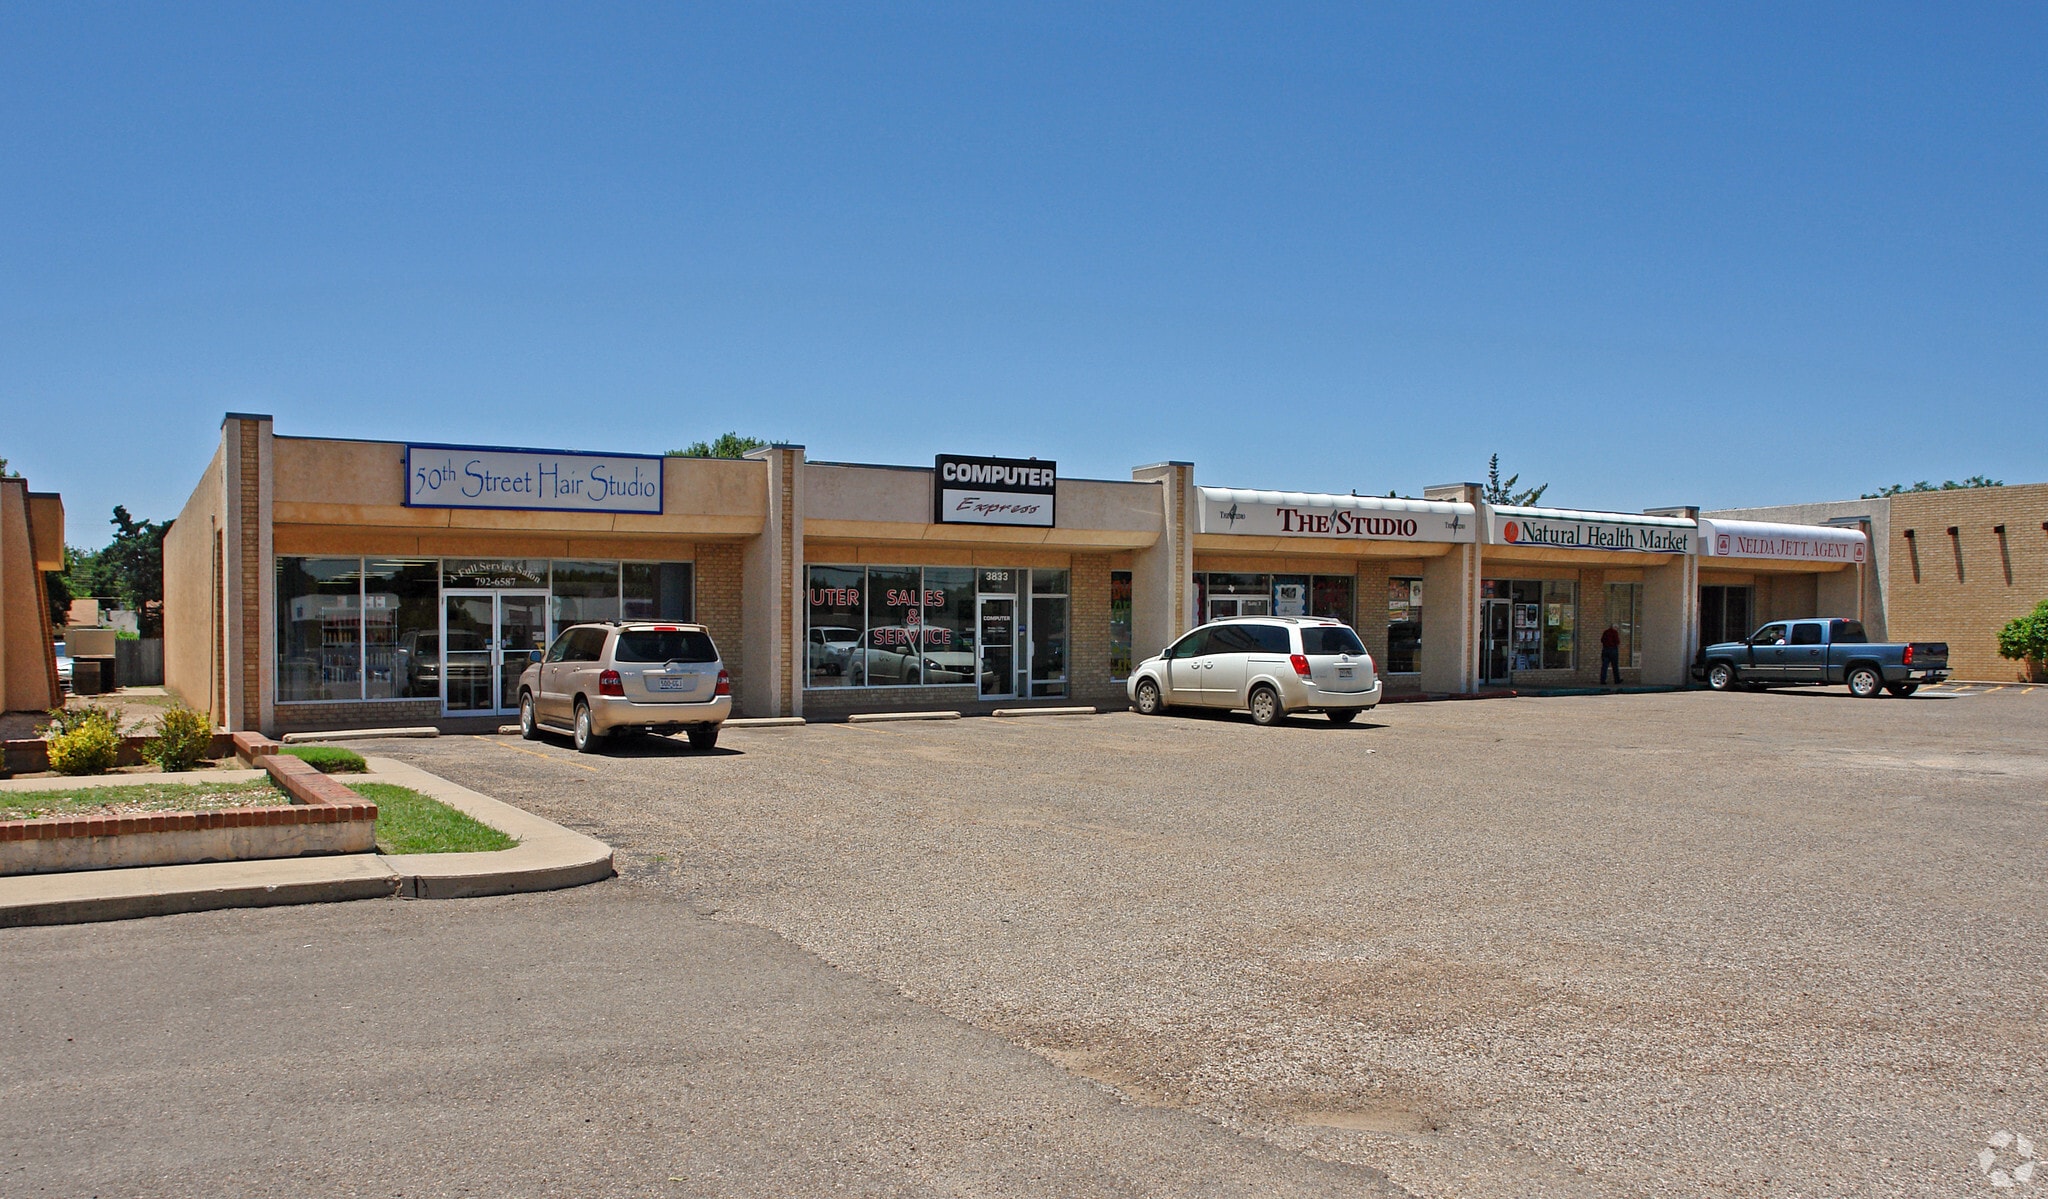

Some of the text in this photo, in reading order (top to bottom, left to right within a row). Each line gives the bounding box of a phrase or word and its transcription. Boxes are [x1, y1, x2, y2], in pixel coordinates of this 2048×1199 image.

[415, 458, 656, 501] 50th Street Hair Studio
[942, 462, 1054, 487] COMPUTER
[956, 497, 1040, 516] Express
[1521, 521, 1689, 551] Natural Health Market
[1736, 536, 1775, 555] NELDA
[1811, 541, 1849, 558] AGENT
[458, 563, 478, 577] Full
[479, 562, 514, 573] Service
[515, 565, 541, 584] Salon
[475, 577, 516, 586] 792-6587
[985, 572, 1008, 581] 3833
[886, 589, 945, 607] SALES
[906, 608, 921, 625] &
[873, 628, 952, 645] SERVICE
